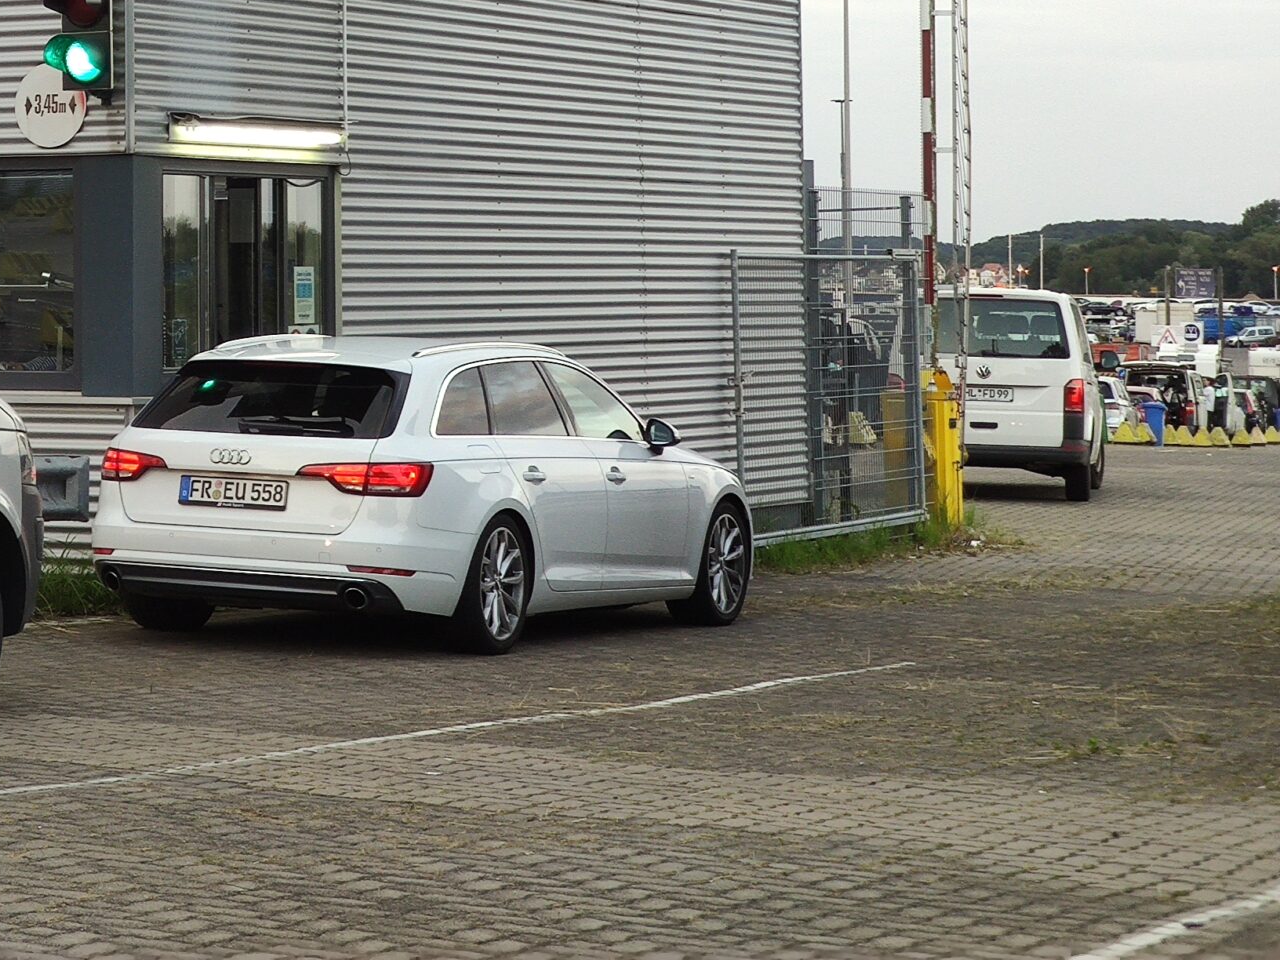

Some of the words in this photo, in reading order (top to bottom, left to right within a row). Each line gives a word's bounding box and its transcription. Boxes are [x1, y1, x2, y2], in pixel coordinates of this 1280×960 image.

[34, 94, 67, 117] 3,45m
[997, 389, 1009, 399] 99
[190, 480, 212, 499] FR
[223, 482, 247, 500] EU
[251, 483, 284, 503] 558
